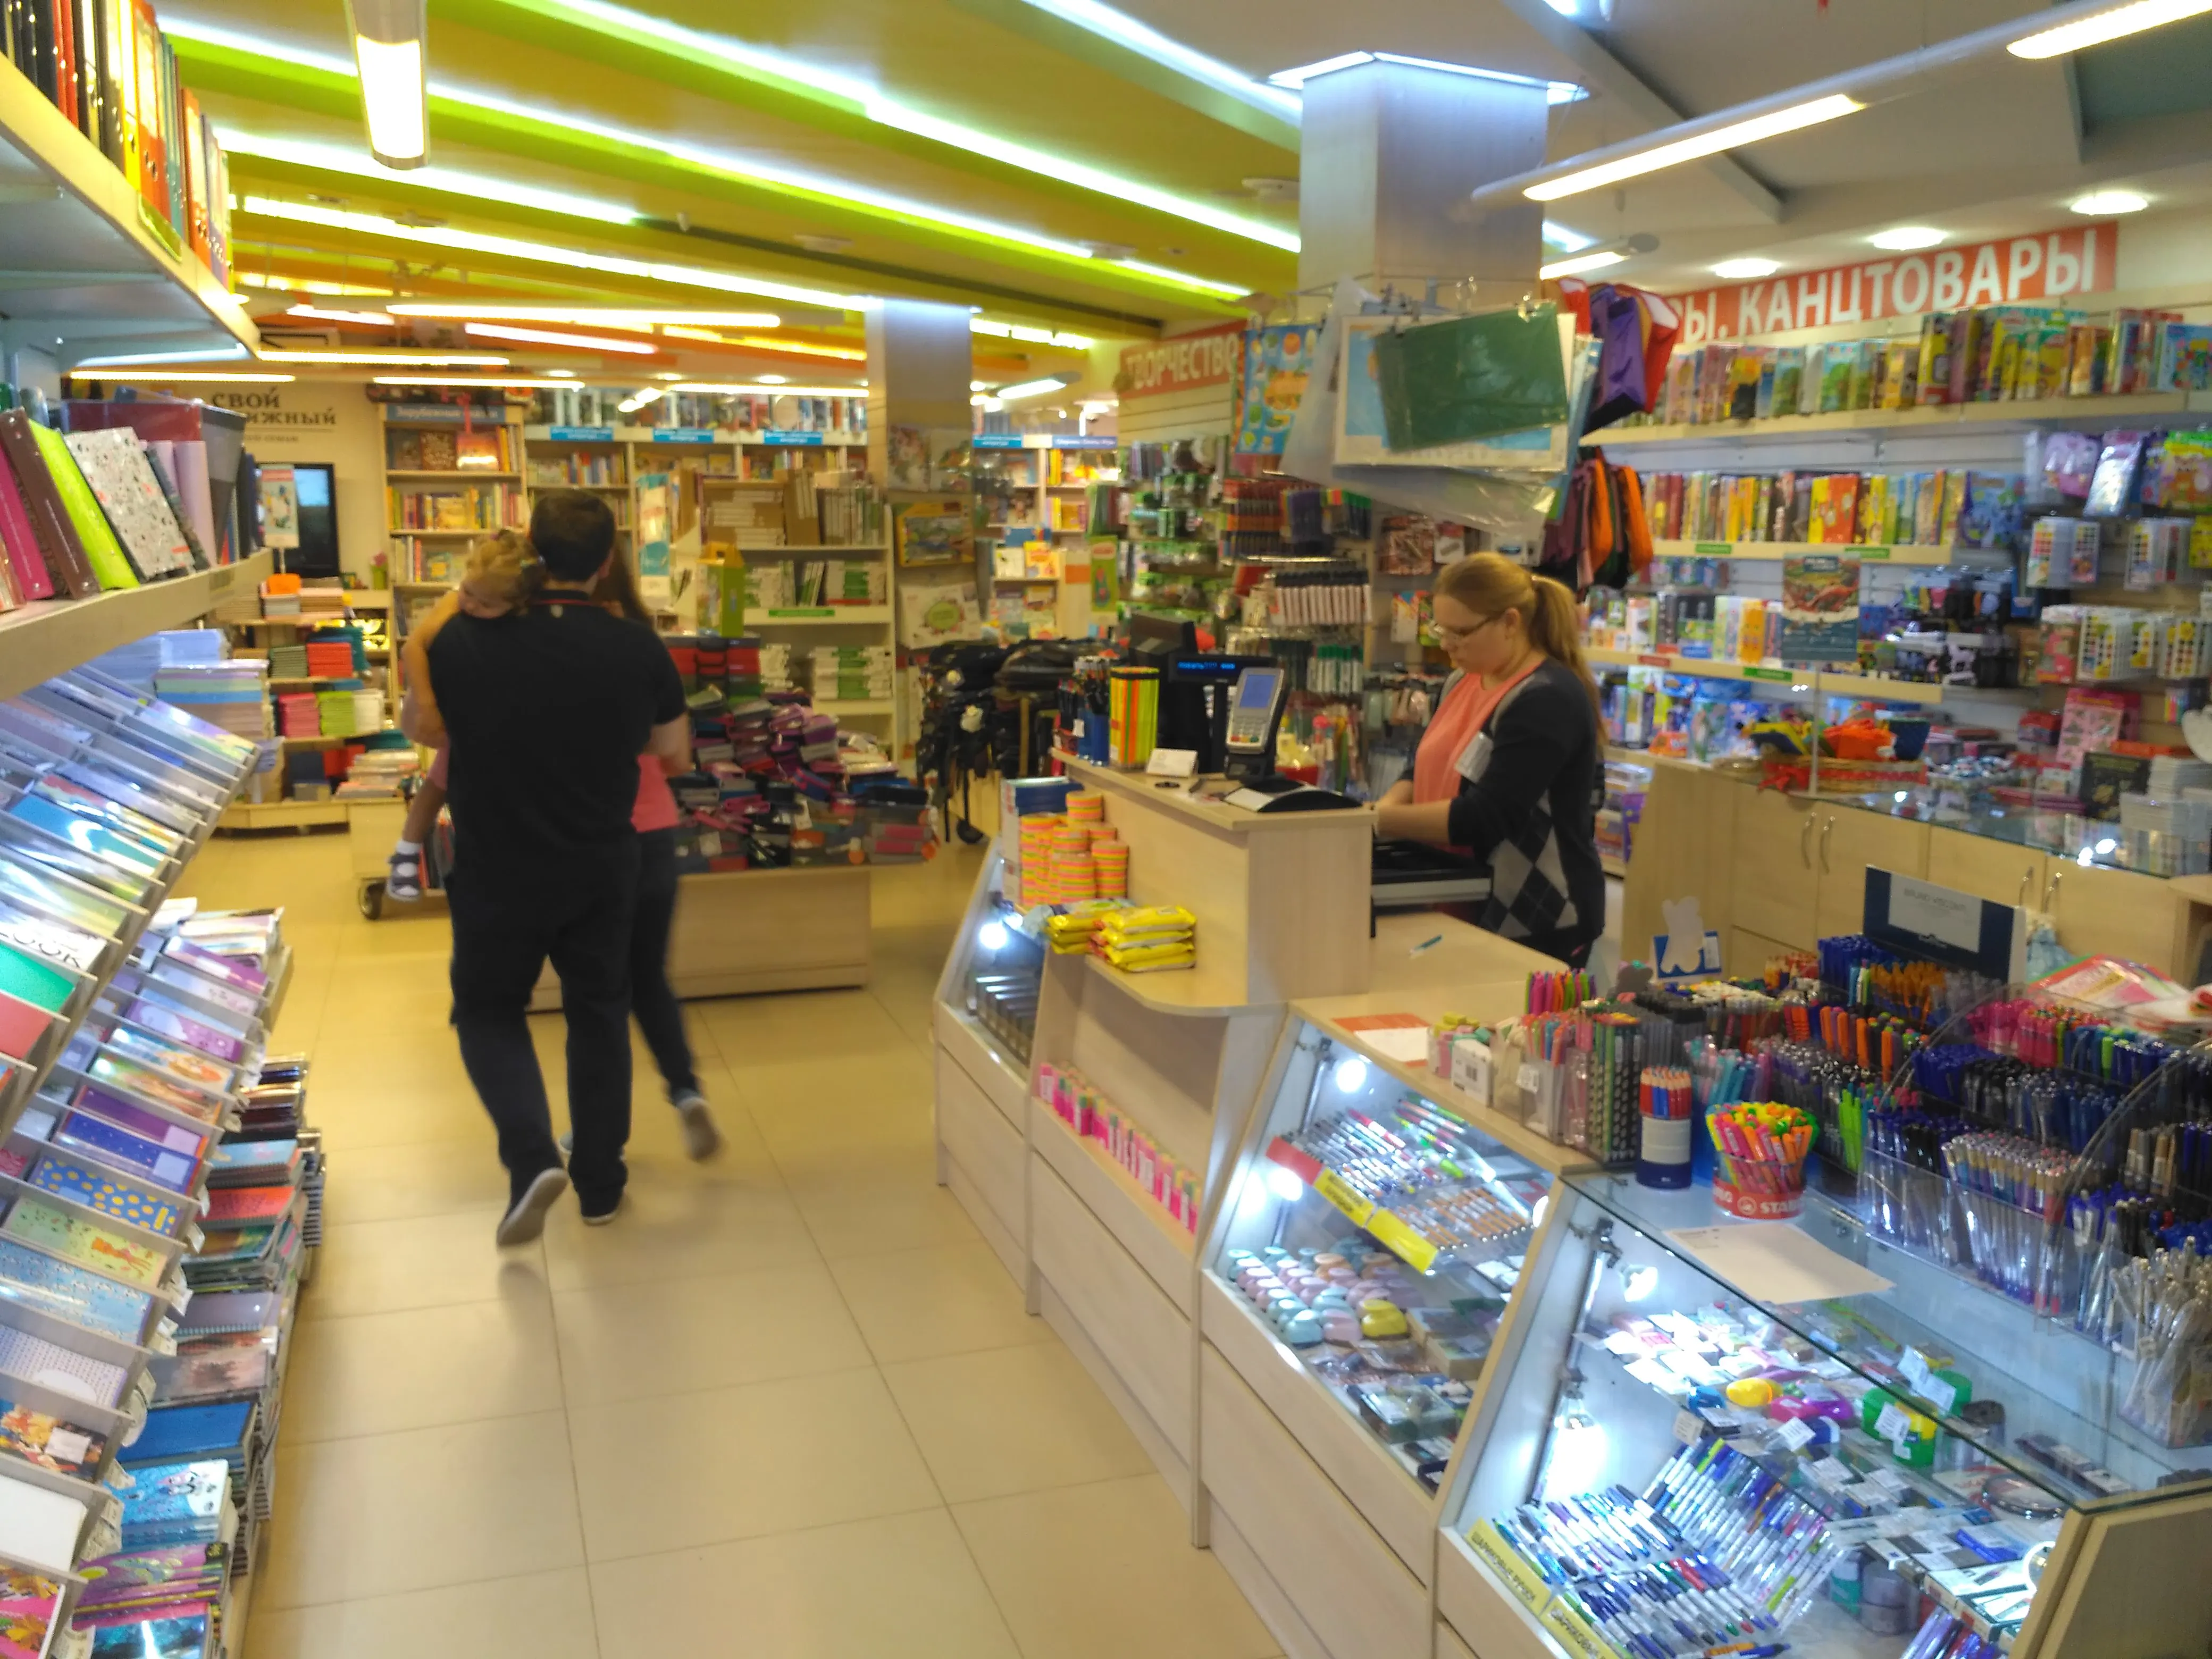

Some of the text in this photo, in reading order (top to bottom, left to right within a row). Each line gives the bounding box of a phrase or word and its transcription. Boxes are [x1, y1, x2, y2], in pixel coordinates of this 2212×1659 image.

[1738, 230, 2097, 339] КАНЦТОВАРЫ
[1126, 333, 1239, 390] ТВОРЧЕСТВО
[212, 386, 280, 408] СВОЙ
[246, 407, 336, 424] ИЖНЫЙ
